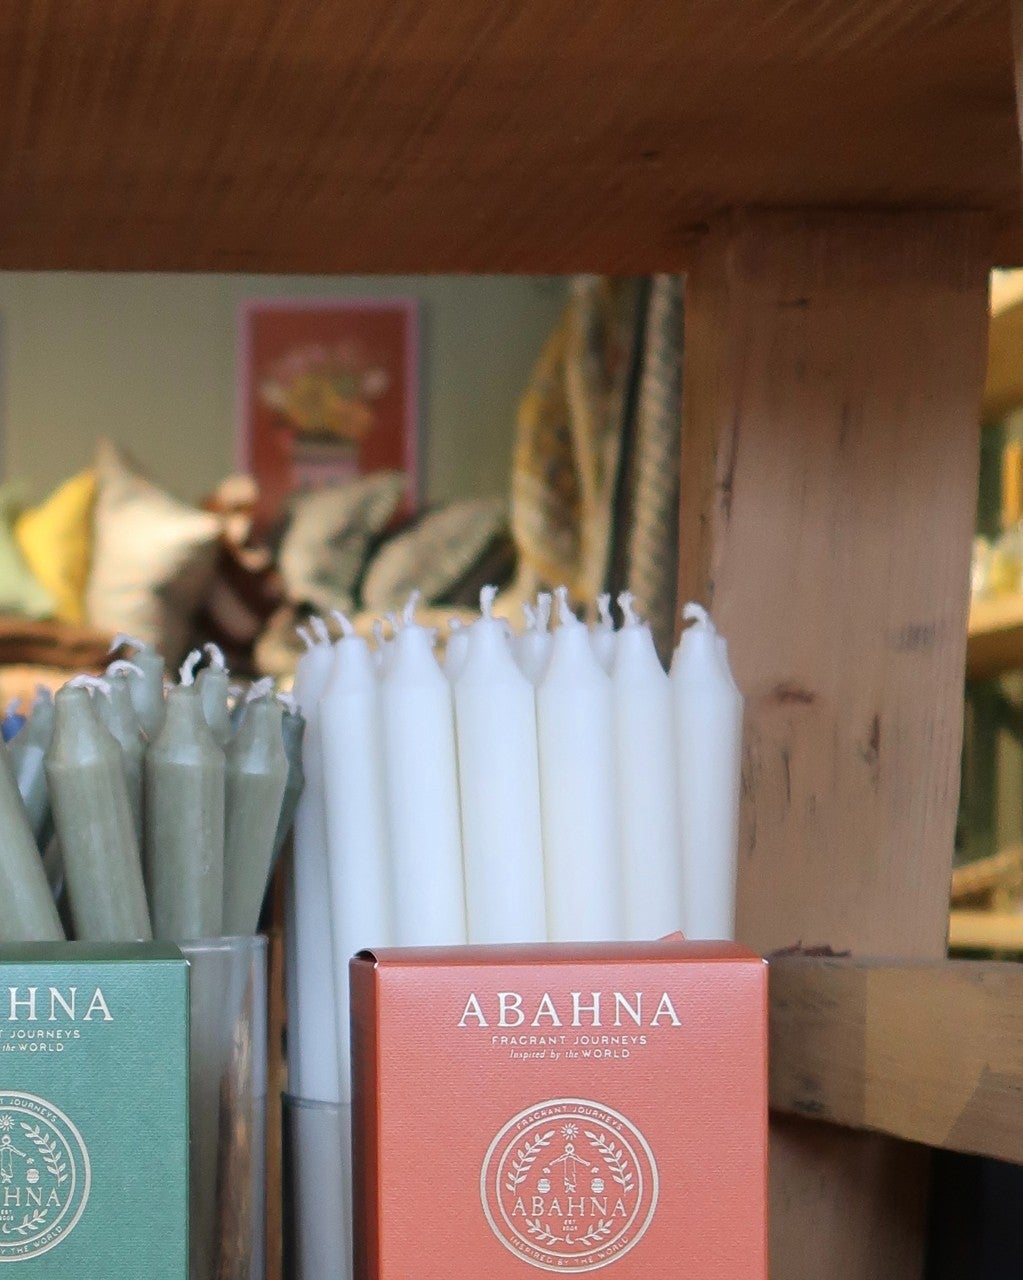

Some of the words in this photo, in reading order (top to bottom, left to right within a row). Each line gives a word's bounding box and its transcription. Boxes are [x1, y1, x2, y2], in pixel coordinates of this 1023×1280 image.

[457, 992, 682, 1027] ABAHNA
[9, 1029, 81, 1039] JOURNEYS
[491, 1036, 566, 1045] FRAGRANT
[573, 1035, 647, 1045] JOURNEYS
[2, 1042, 16, 1052] the
[17, 1042, 64, 1052] WORLD
[510, 1049, 546, 1061] Inspired
[550, 1049, 561, 1061] by
[565, 1049, 579, 1059] the
[581, 1049, 630, 1059] WORLD
[9, 1098, 58, 1123] JOURNEYS
[511, 1196, 627, 1217] ABAHNA
